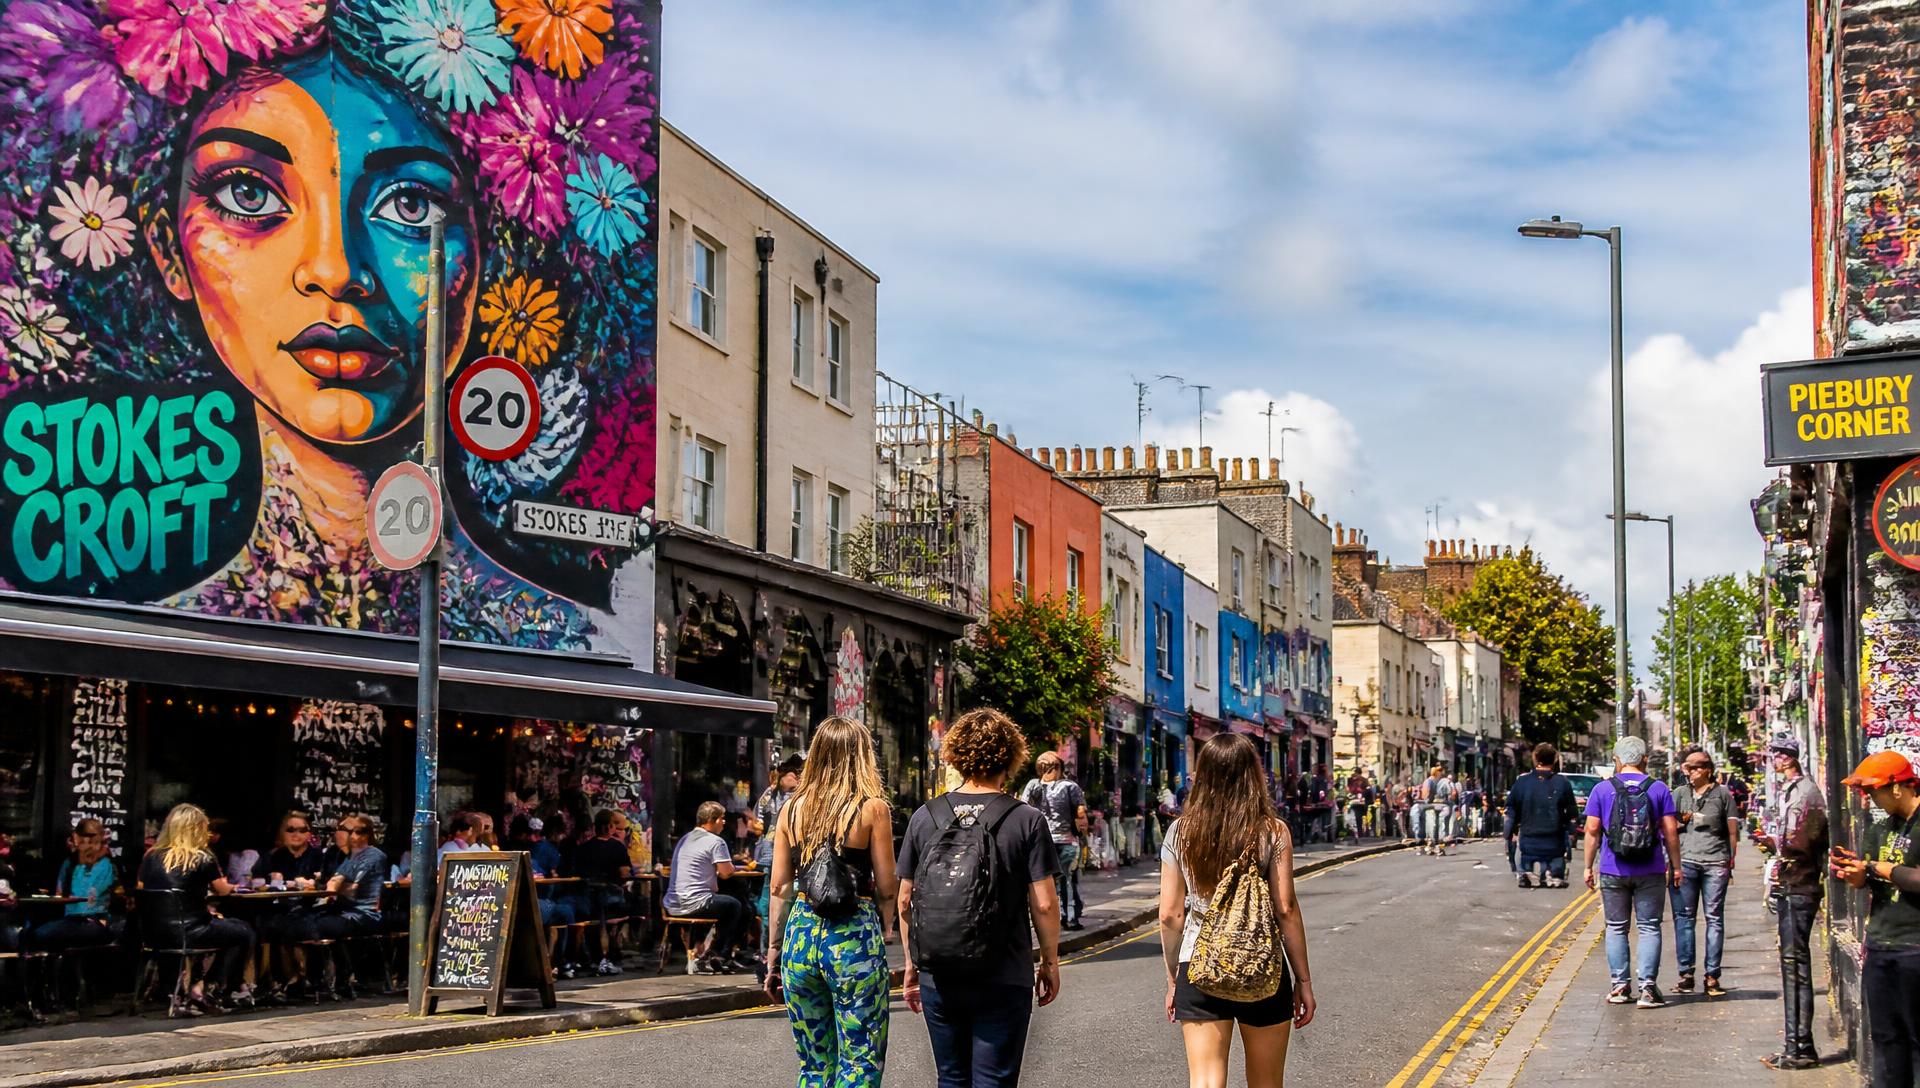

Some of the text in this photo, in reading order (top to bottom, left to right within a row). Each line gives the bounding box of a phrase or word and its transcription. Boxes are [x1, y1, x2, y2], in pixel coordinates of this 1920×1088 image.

[464, 387, 525, 429] 20
[1788, 374, 1913, 412] PIEBURY
[3, 389, 241, 495] STOKES
[1797, 406, 1911, 442] CORNER
[12, 481, 228, 582] CROFT
[379, 495, 431, 536] 20
